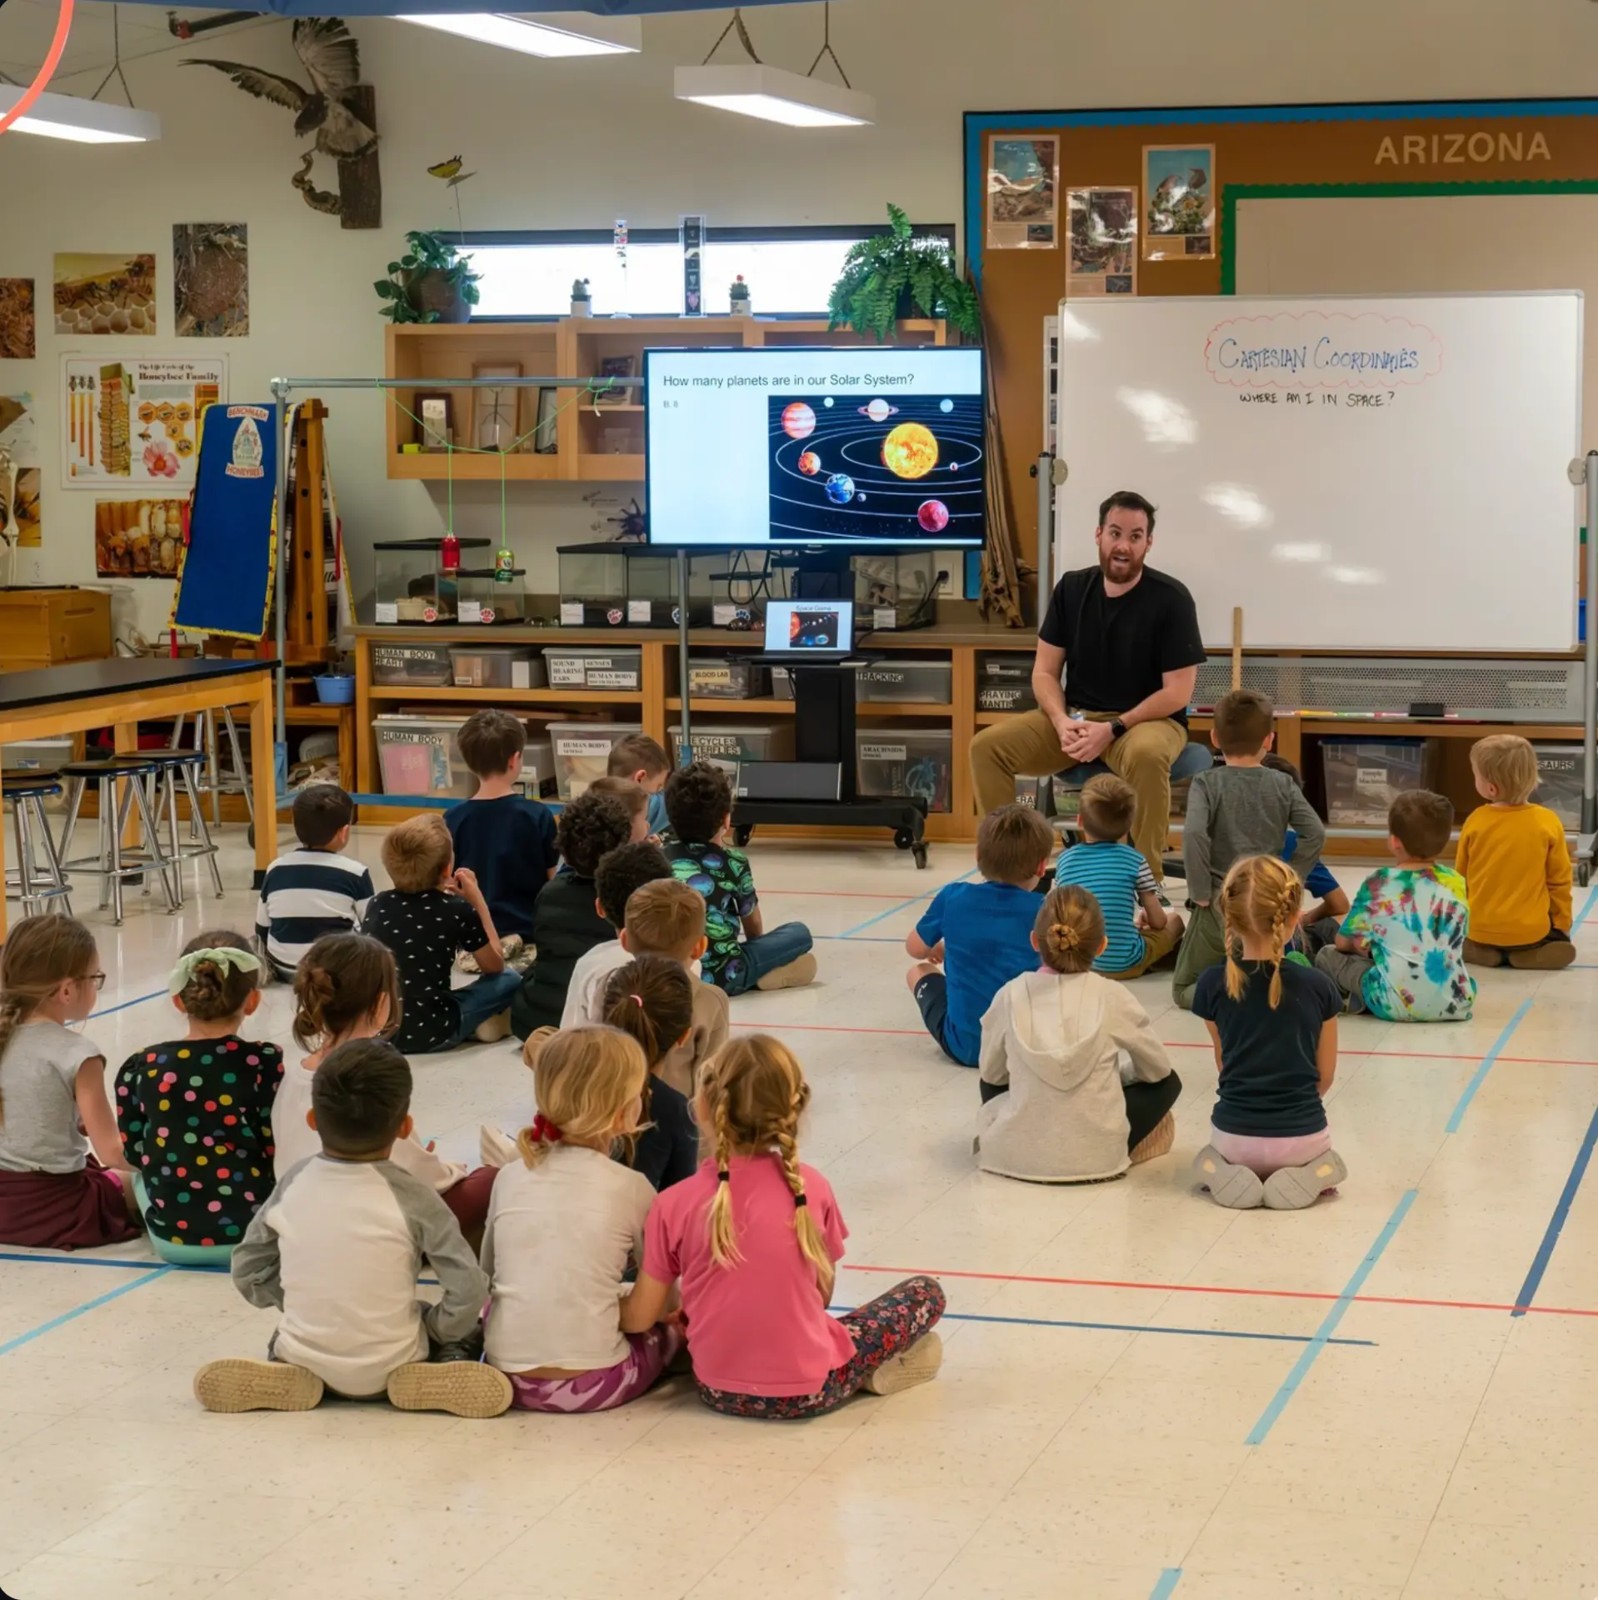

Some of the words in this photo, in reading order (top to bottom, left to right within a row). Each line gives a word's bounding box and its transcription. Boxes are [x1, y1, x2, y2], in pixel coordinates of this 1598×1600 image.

[1374, 131, 1552, 165] ARIZONA
[138, 372, 185, 383] Honeybee
[186, 372, 220, 384] Family
[663, 375, 690, 387] How
[692, 376, 724, 390] many
[727, 375, 770, 389] planets
[772, 377, 791, 387] are
[794, 374, 805, 386] in
[807, 376, 827, 386] our
[830, 373, 861, 386] Solar
[864, 373, 915, 389] System?
[1240, 392, 1279, 404] WHERE
[1286, 391, 1301, 404] AM
[1305, 391, 1315, 405] I
[1322, 393, 1338, 405] IN
[375, 648, 404, 659] HUMAN
[410, 649, 436, 660] BODY
[375, 657, 404, 668] HEART
[979, 690, 1021, 700] PRAYING
[383, 731, 414, 742] HUMAN
[418, 734, 443, 744] BODY
[676, 735, 699, 746] LE
[699, 736, 737, 746] CYCLES
[1537, 759, 1575, 770] SAURS
